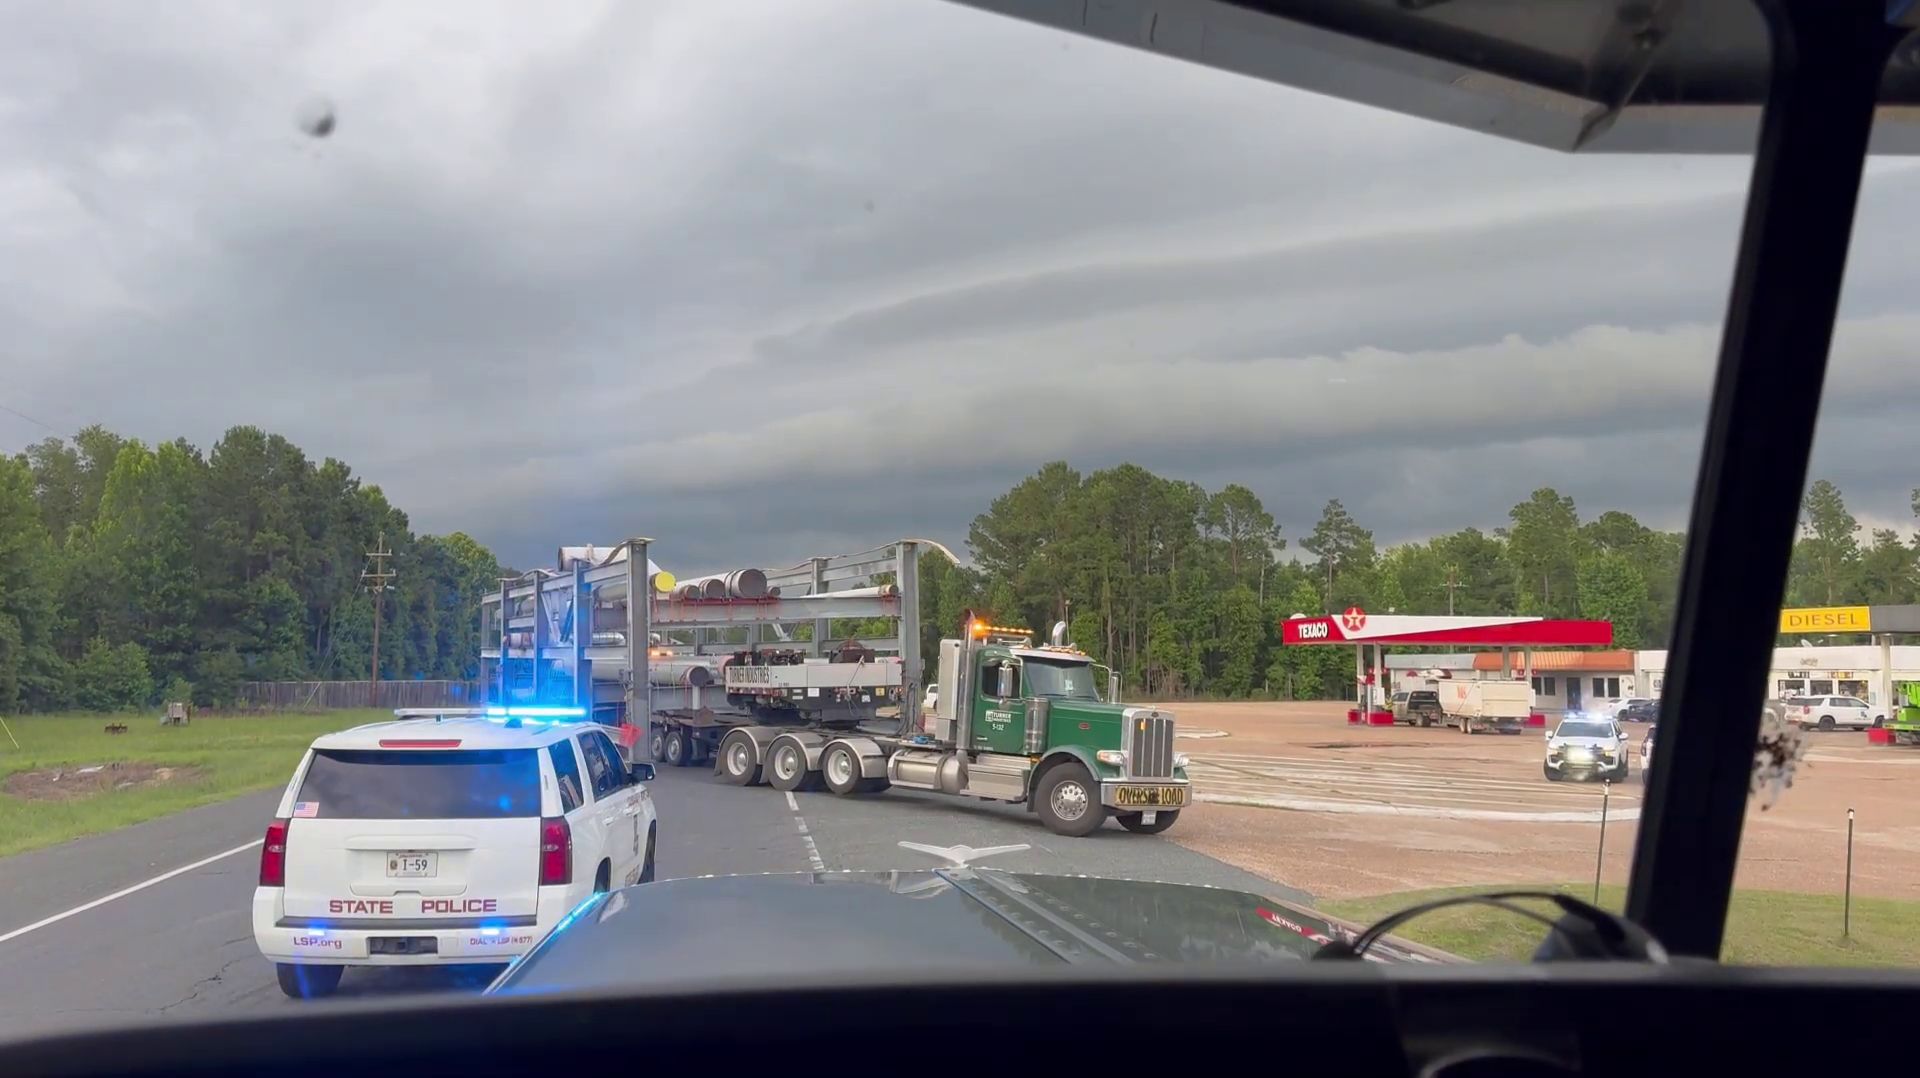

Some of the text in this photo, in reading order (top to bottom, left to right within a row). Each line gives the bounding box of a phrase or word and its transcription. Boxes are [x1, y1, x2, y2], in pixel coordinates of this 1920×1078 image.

[1789, 613, 1859, 627] DIESEL
[1298, 622, 1328, 639] TEXACO
[729, 666, 770, 684] TURNER INDUSTRIES
[1119, 787, 1183, 805] OVERSIE LOAD
[403, 859, 428, 871] I-59
[329, 899, 497, 914] STATE POLICE
[293, 936, 342, 949] LSP.org
[469, 937, 488, 945] DIAL
